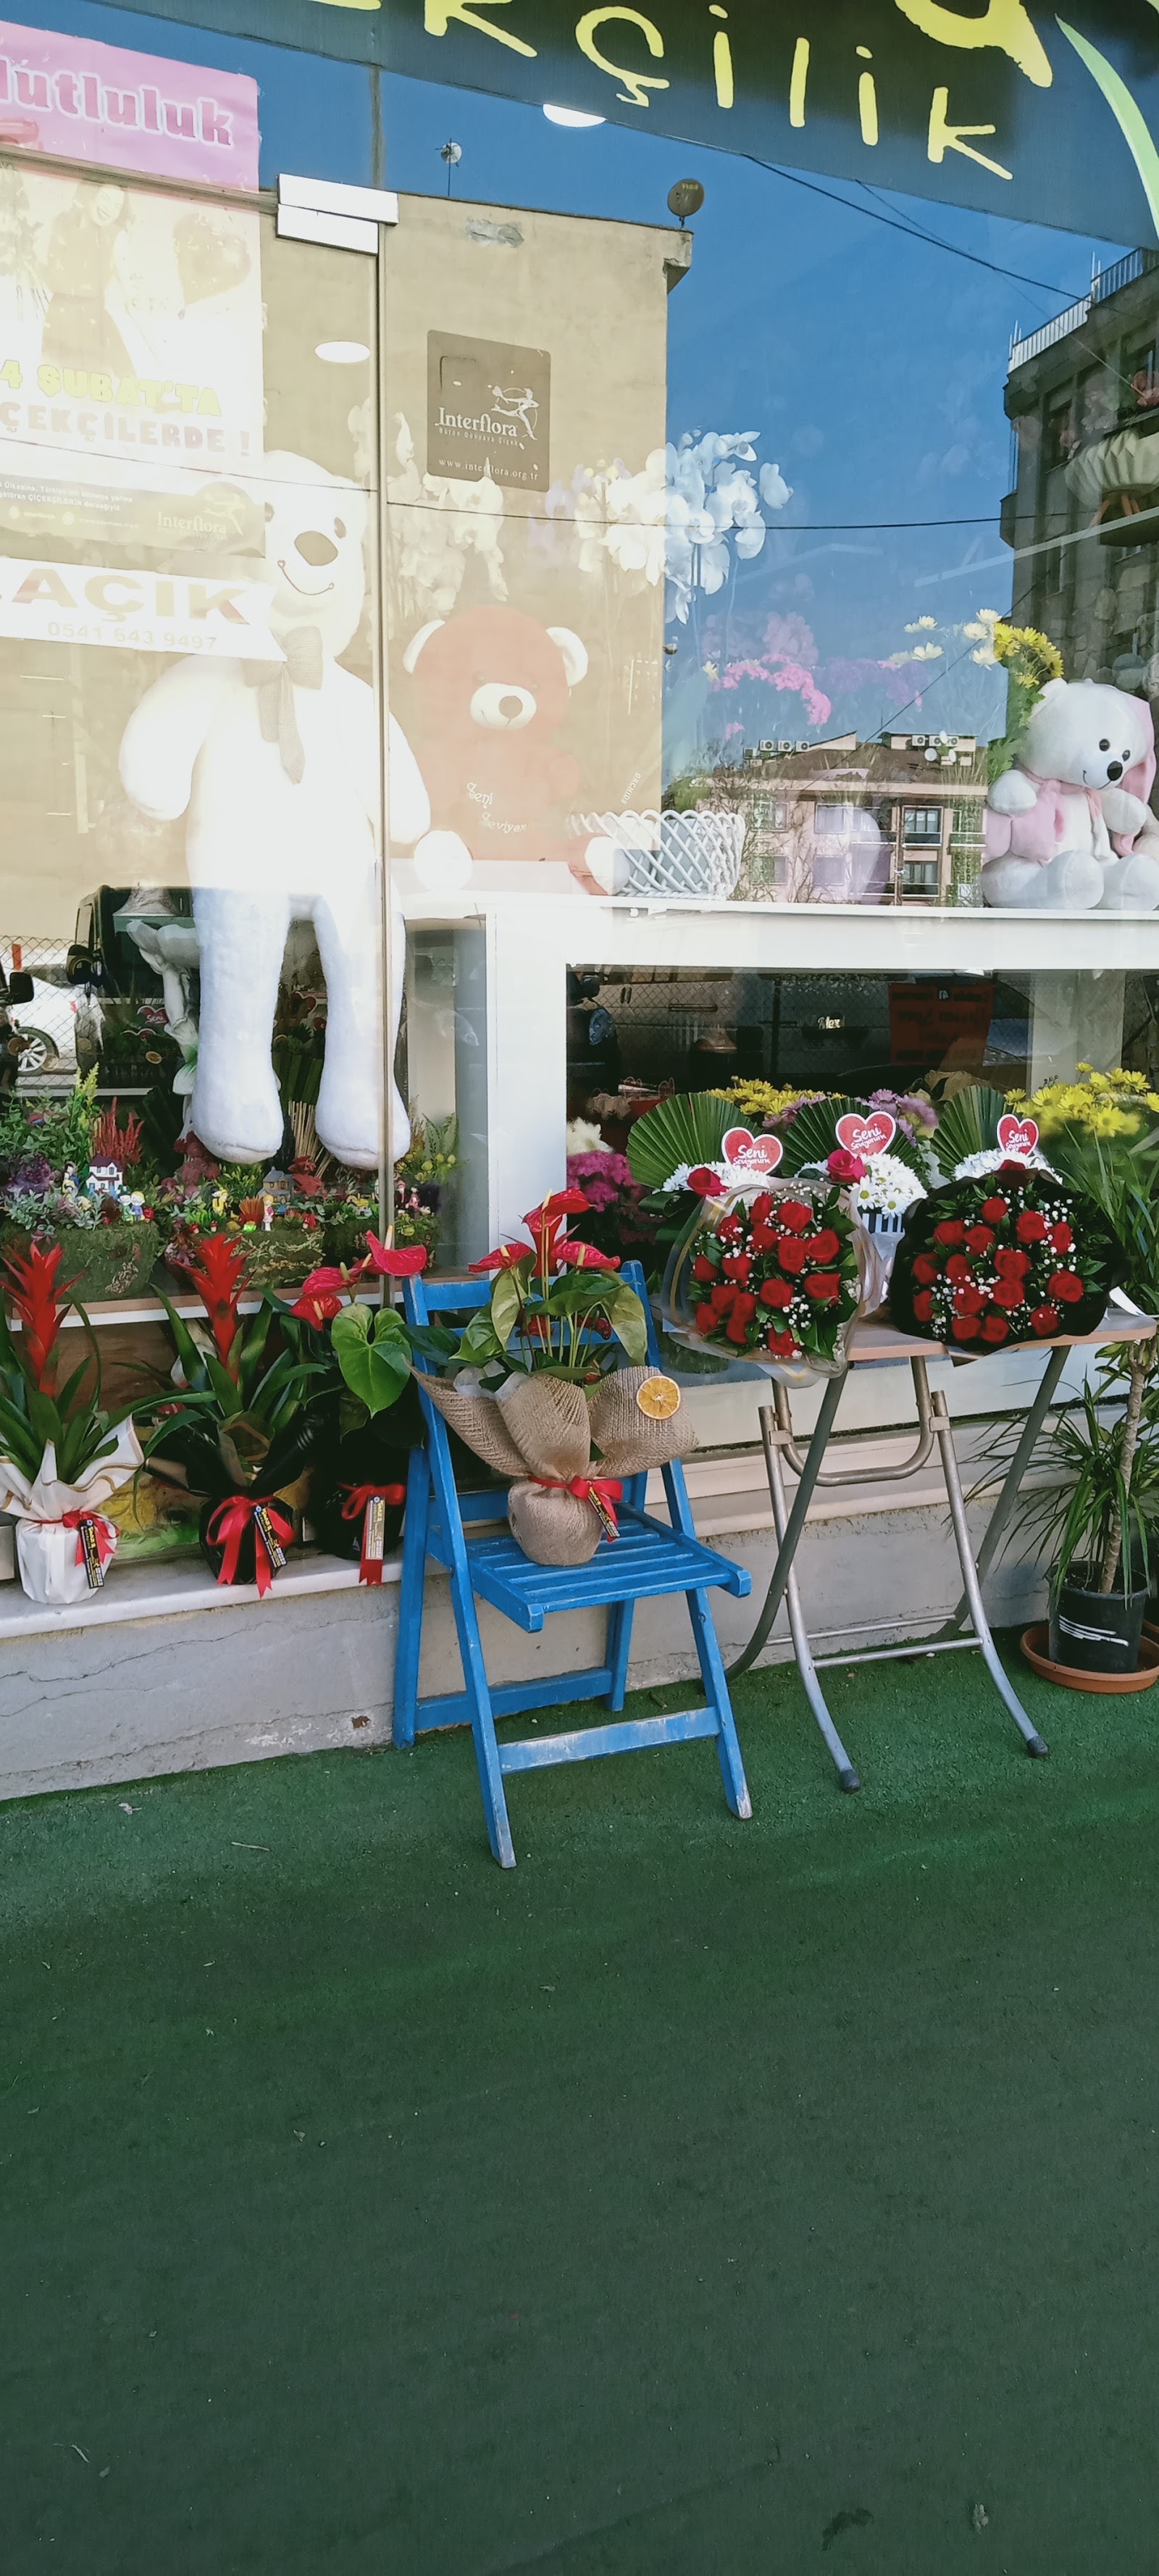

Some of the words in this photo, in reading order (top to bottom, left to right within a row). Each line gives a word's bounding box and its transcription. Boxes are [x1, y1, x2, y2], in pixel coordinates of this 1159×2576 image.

[438, 406, 518, 438] Interflora
[438, 458, 539, 481] www.intelora.org.tr
[156, 510, 227, 534] Interflora
[12, 567, 251, 625] AÇIK
[48, 621, 103, 640] 0541
[114, 627, 155, 645] 643
[163, 632, 217, 650] 9497
[620, 771, 642, 806] ORCHIDS
[852, 1123, 882, 1143] Seni
[1008, 1128, 1029, 1144] Seni
[737, 1144, 768, 1159] Seni
